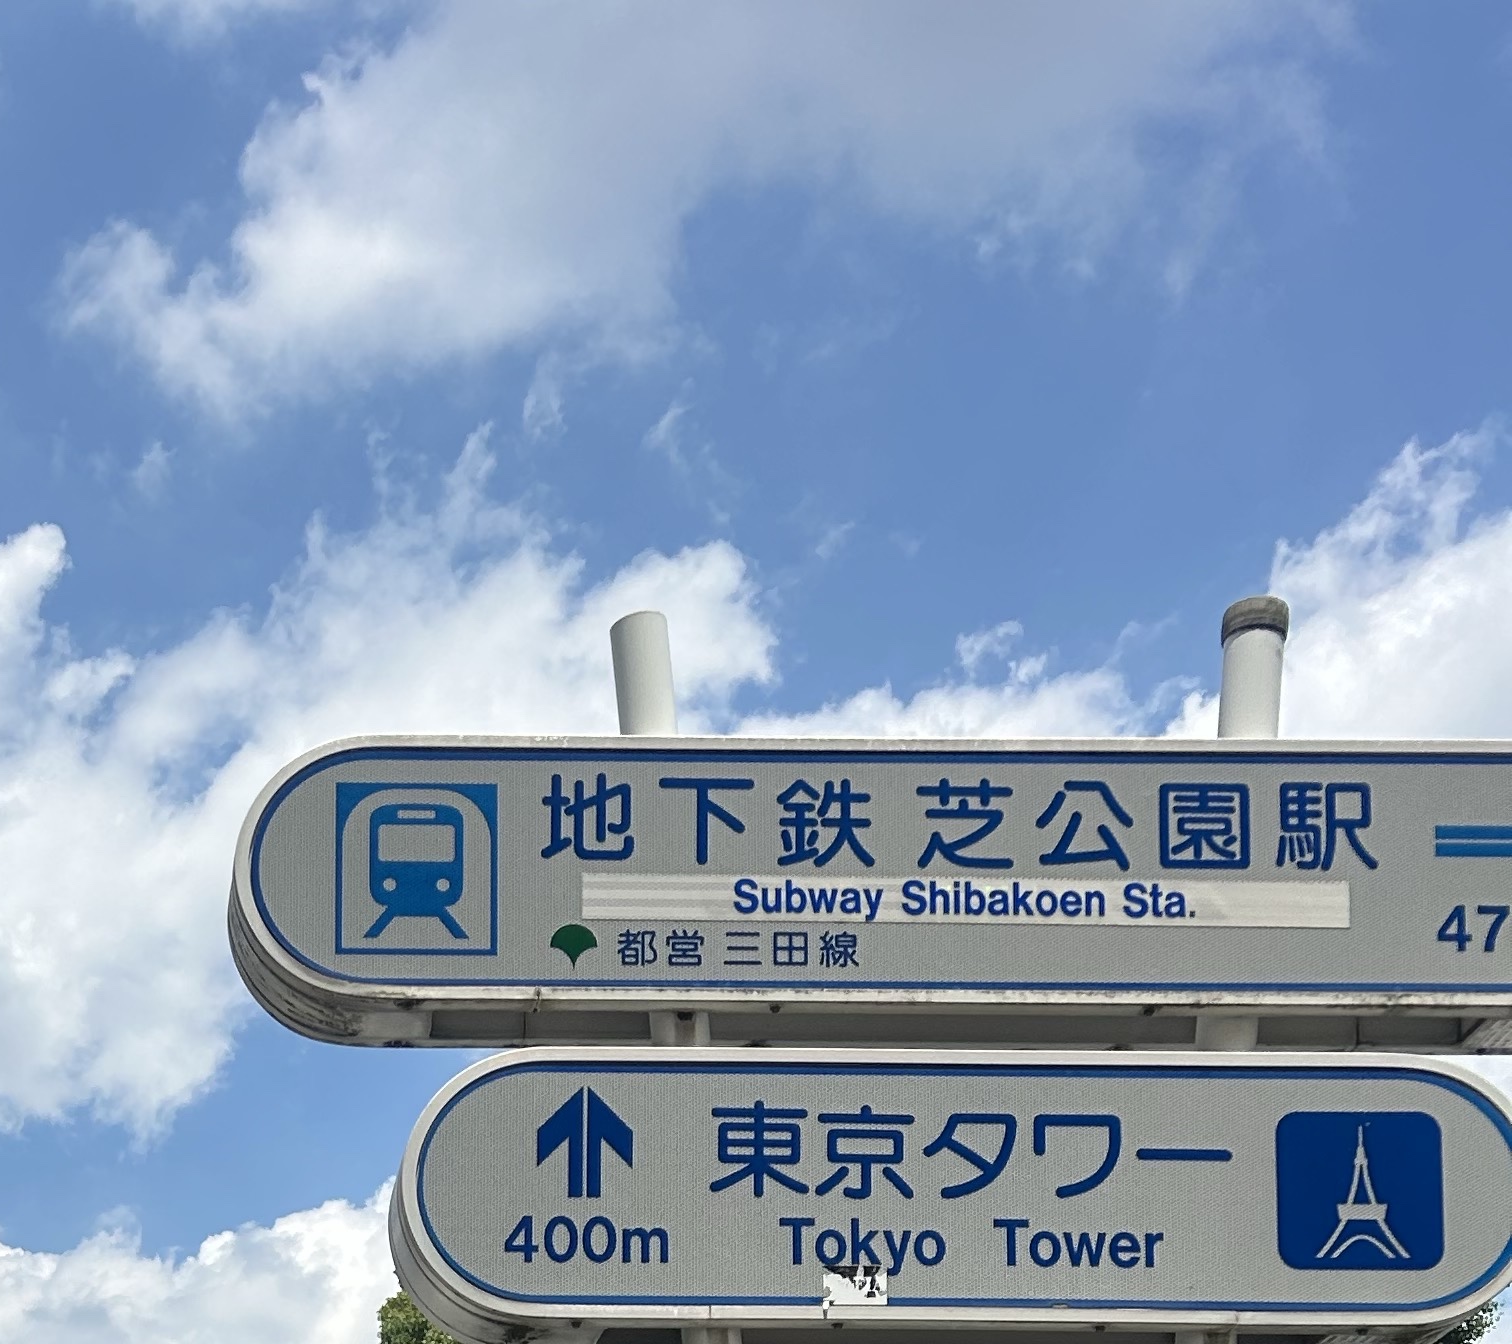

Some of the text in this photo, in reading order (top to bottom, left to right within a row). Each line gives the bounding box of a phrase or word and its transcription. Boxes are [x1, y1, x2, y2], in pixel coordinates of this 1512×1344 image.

[733, 880, 1196, 925] Subway Shibakoen Sta.
[1437, 904, 1510, 953] 47
[709, 1100, 1234, 1201] 東京タワー
[503, 1215, 670, 1266] 400m
[778, 1217, 1165, 1277] Tokyo Tower
